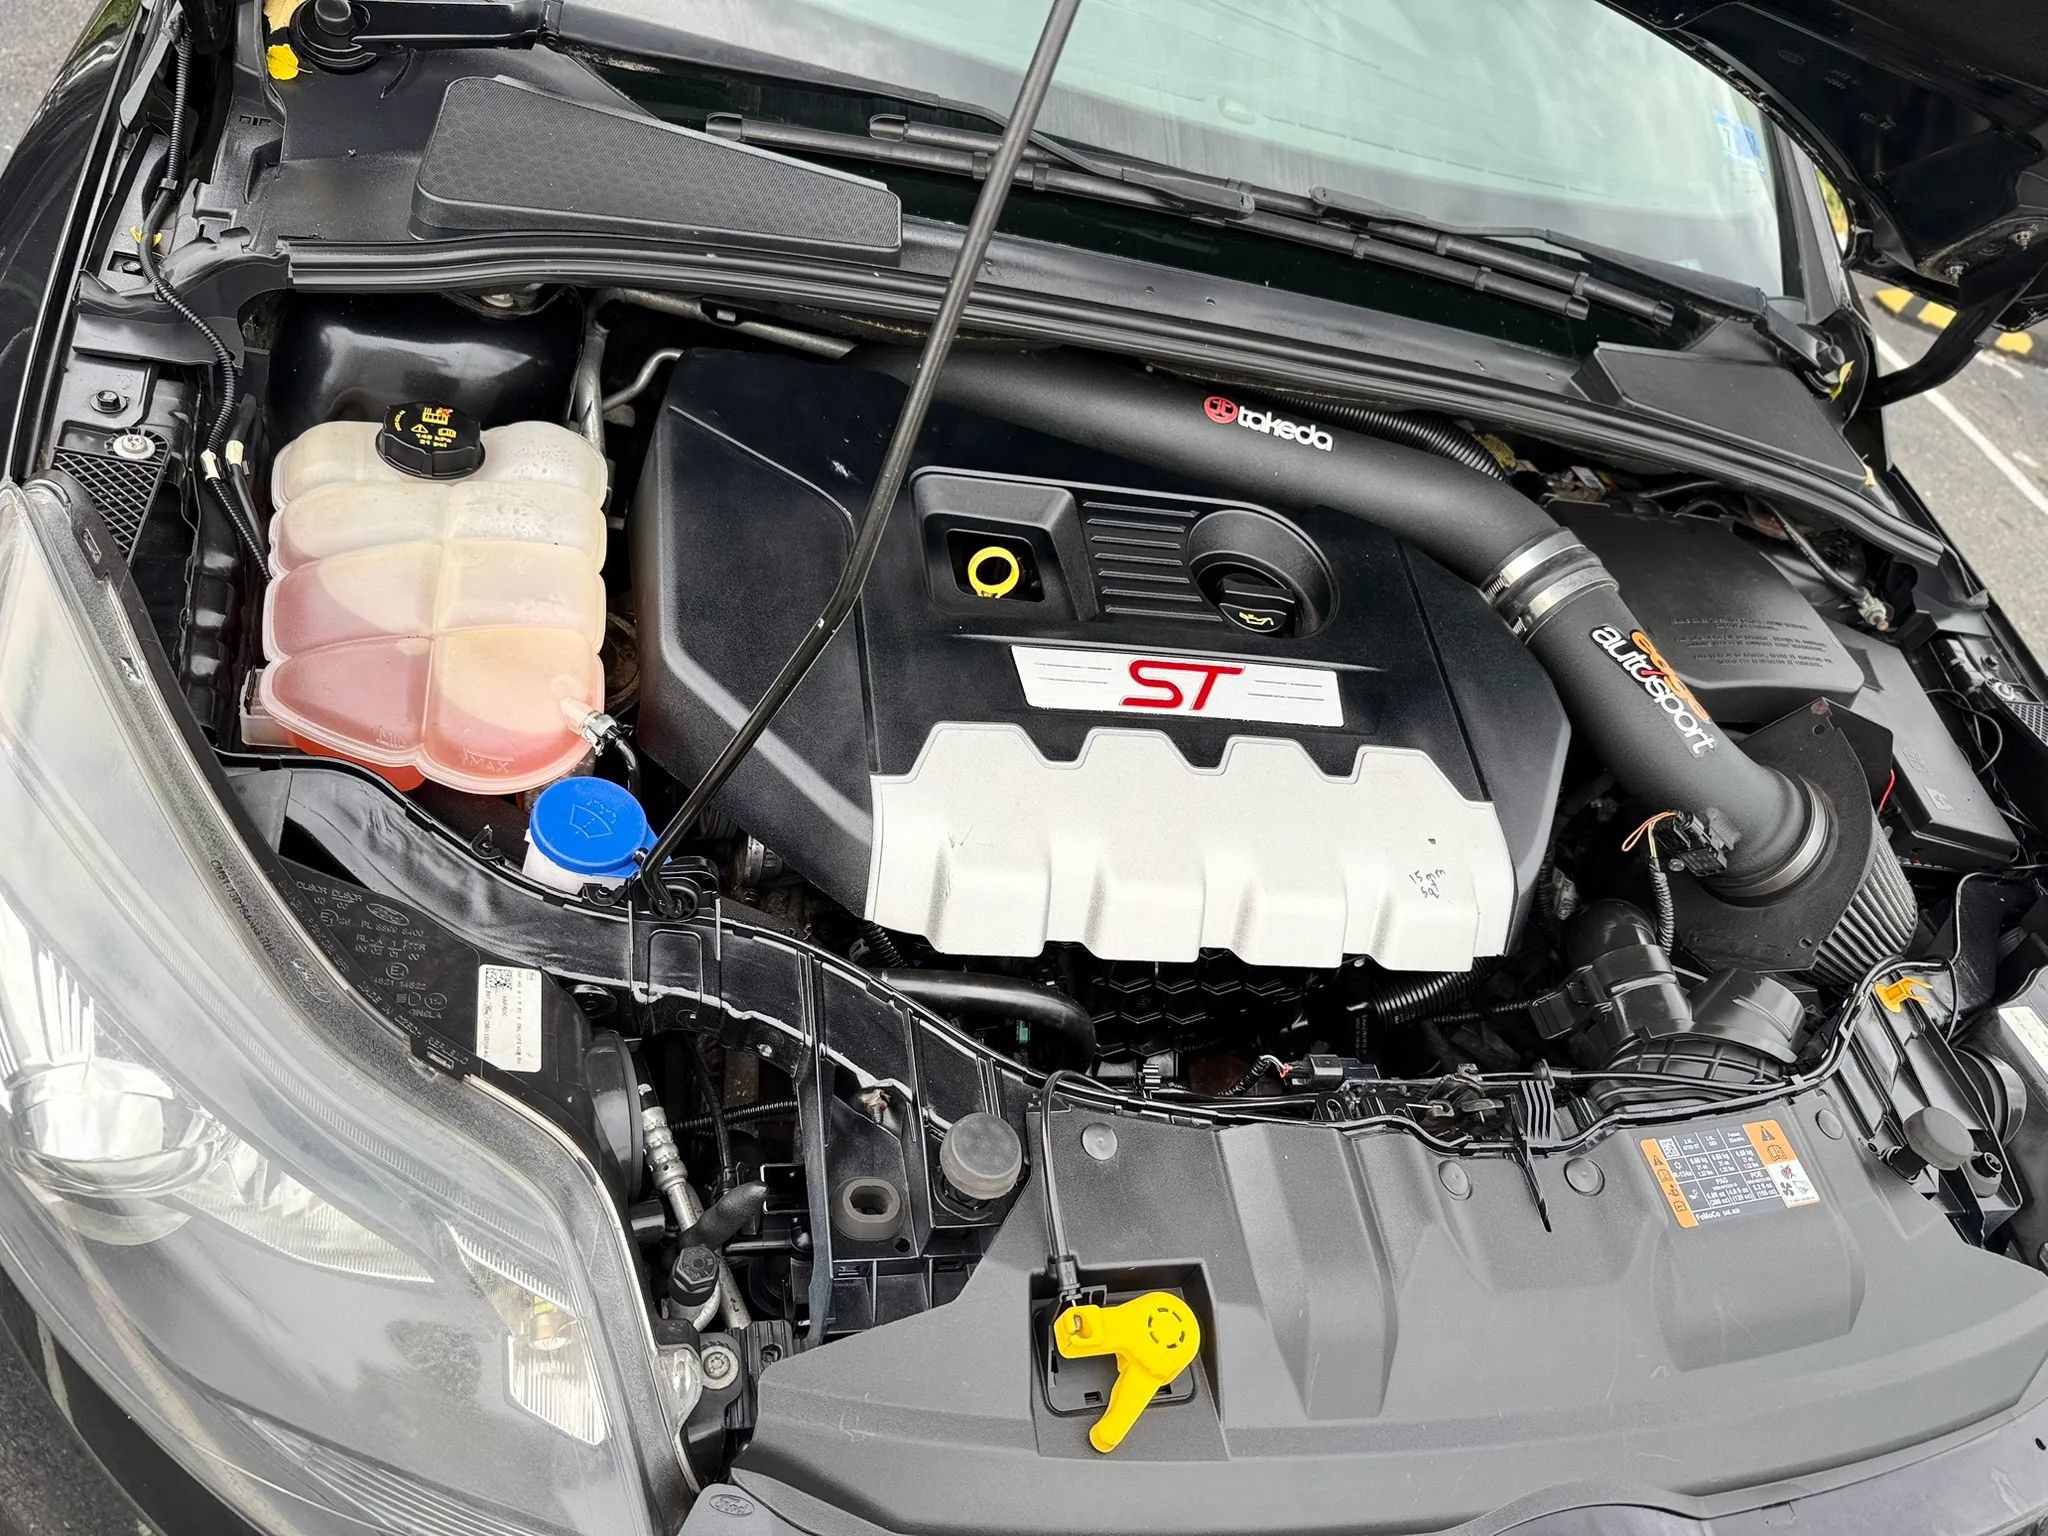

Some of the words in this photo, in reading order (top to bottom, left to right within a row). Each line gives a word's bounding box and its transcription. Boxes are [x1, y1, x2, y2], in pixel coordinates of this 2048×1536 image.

[1237, 405, 1334, 452] takeda
[1120, 659, 1244, 710] ST
[1591, 626, 1716, 755] autosport
[470, 755, 510, 774] MAX
[1695, 1210, 1721, 1221] FoMoCo
